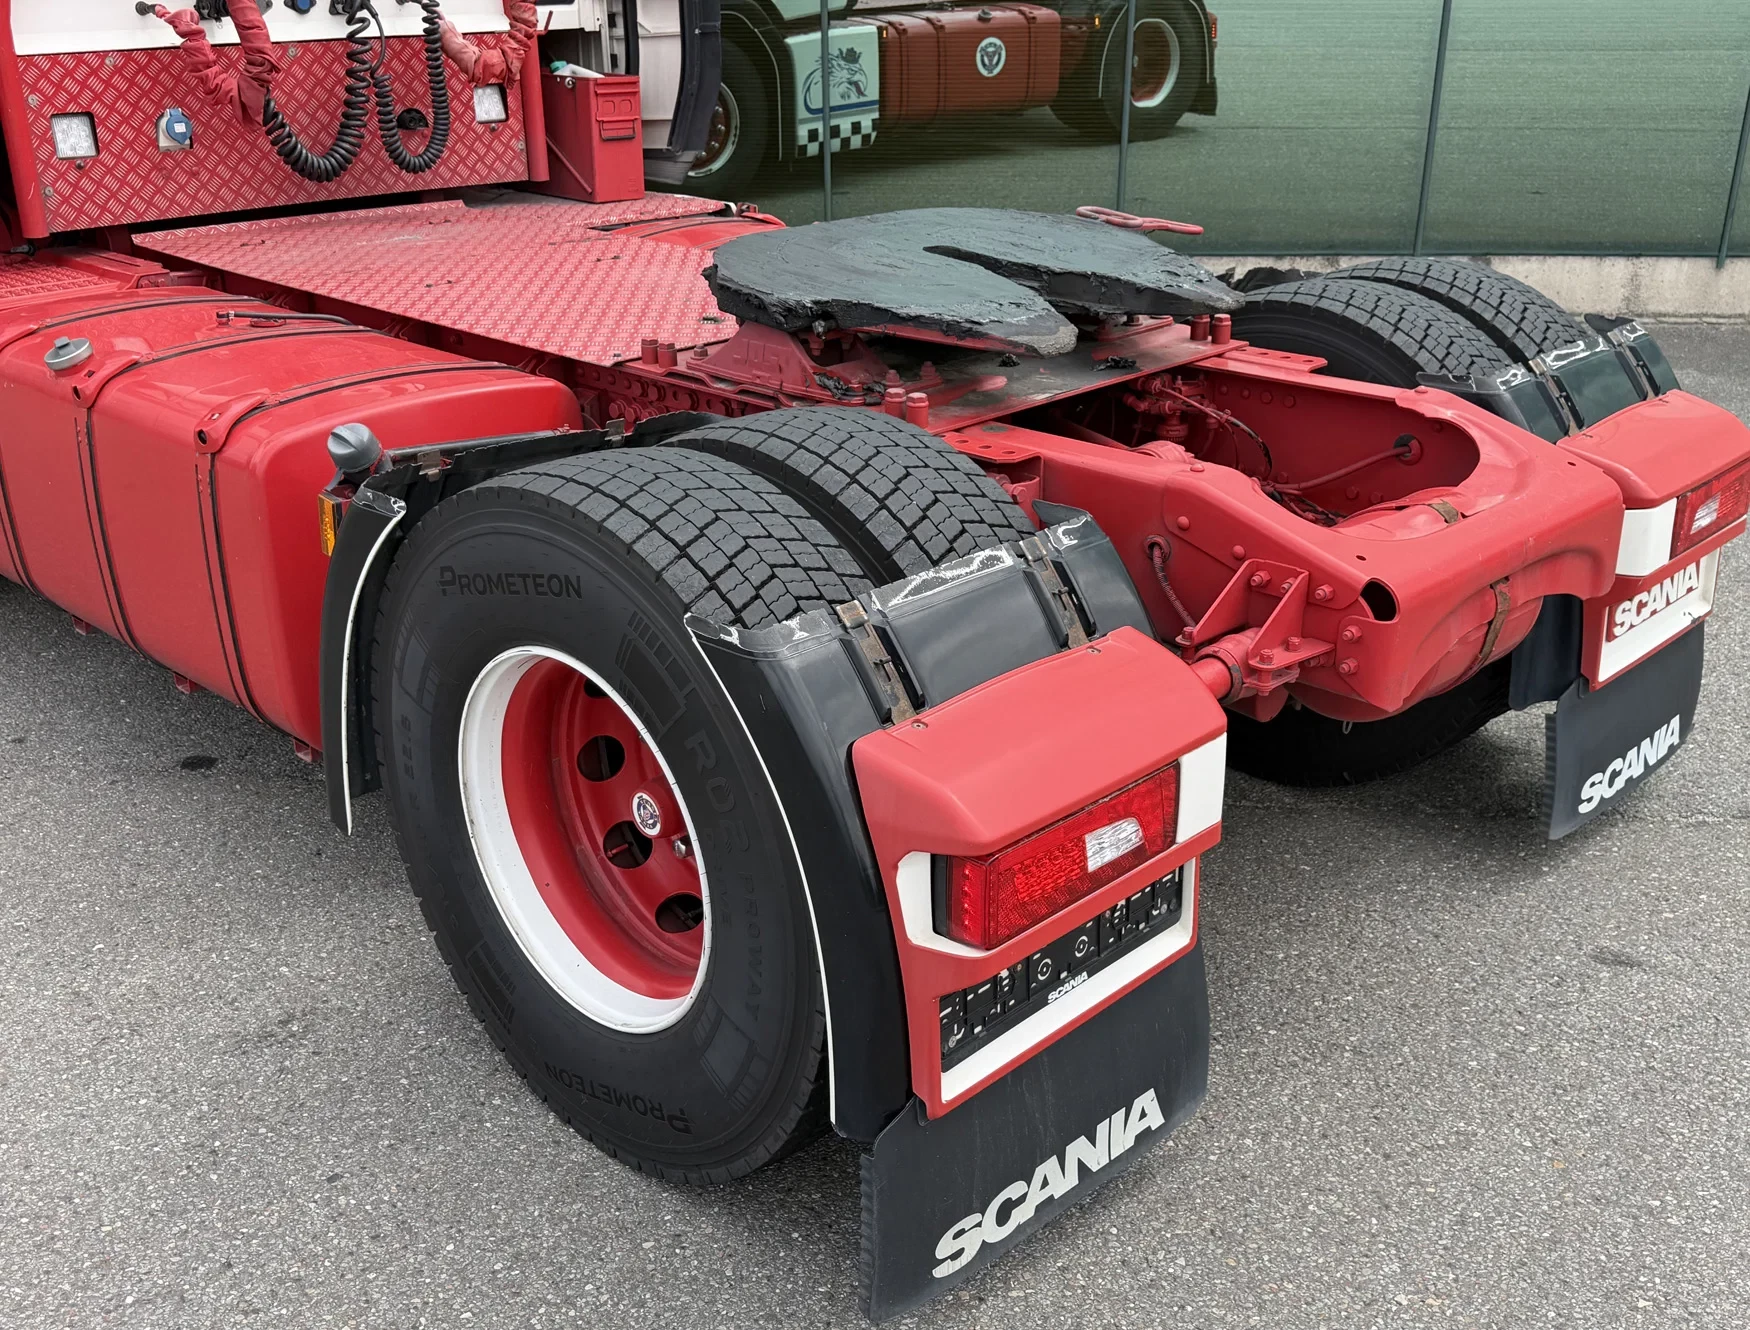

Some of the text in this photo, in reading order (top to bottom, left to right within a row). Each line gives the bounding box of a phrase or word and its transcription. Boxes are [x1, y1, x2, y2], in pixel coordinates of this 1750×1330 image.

[437, 565, 583, 600] PROMETEON
[1613, 562, 1698, 637] SCANIA
[1578, 714, 1680, 814] SCANIA
[737, 871, 763, 1022] PROWAY
[1048, 971, 1088, 1003] SCANIA
[545, 1062, 696, 1135] PROMETEON
[932, 1088, 1165, 1278] SCANIA
